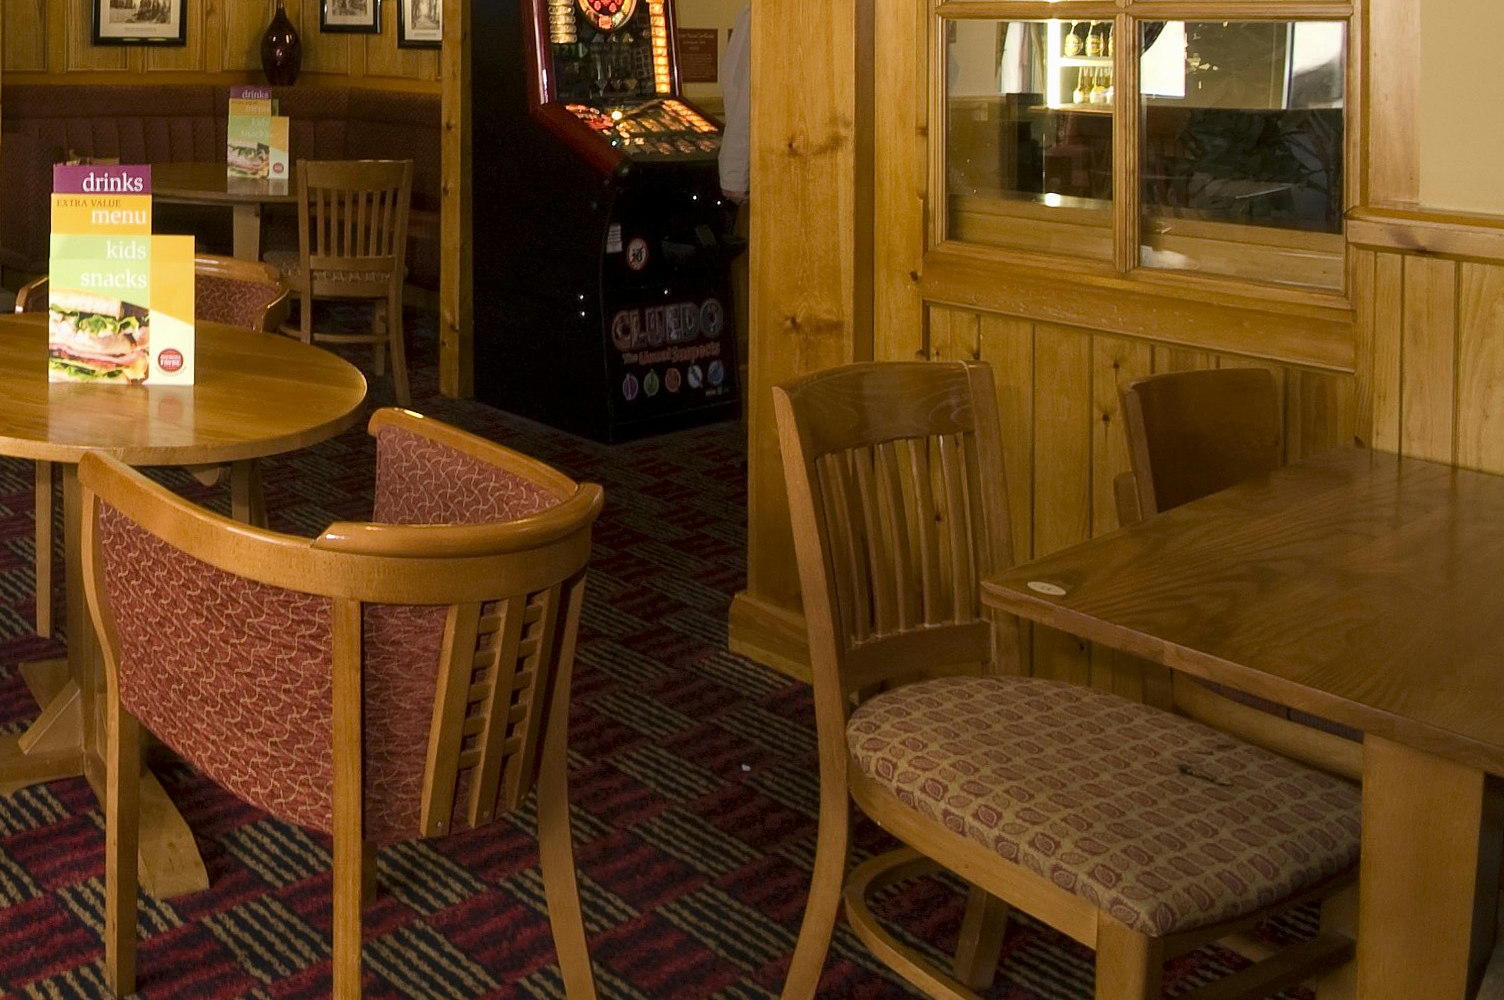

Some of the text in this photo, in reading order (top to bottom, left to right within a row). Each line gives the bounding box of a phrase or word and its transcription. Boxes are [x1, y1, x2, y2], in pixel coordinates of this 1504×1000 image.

[241, 90, 269, 99] drinks
[82, 172, 144, 193] drinks
[56, 198, 122, 208] EXTRA VALUE
[91, 209, 147, 226] menu
[106, 240, 147, 260] kids
[80, 269, 148, 289] snacks
[611, 298, 724, 351] CLUEDO
